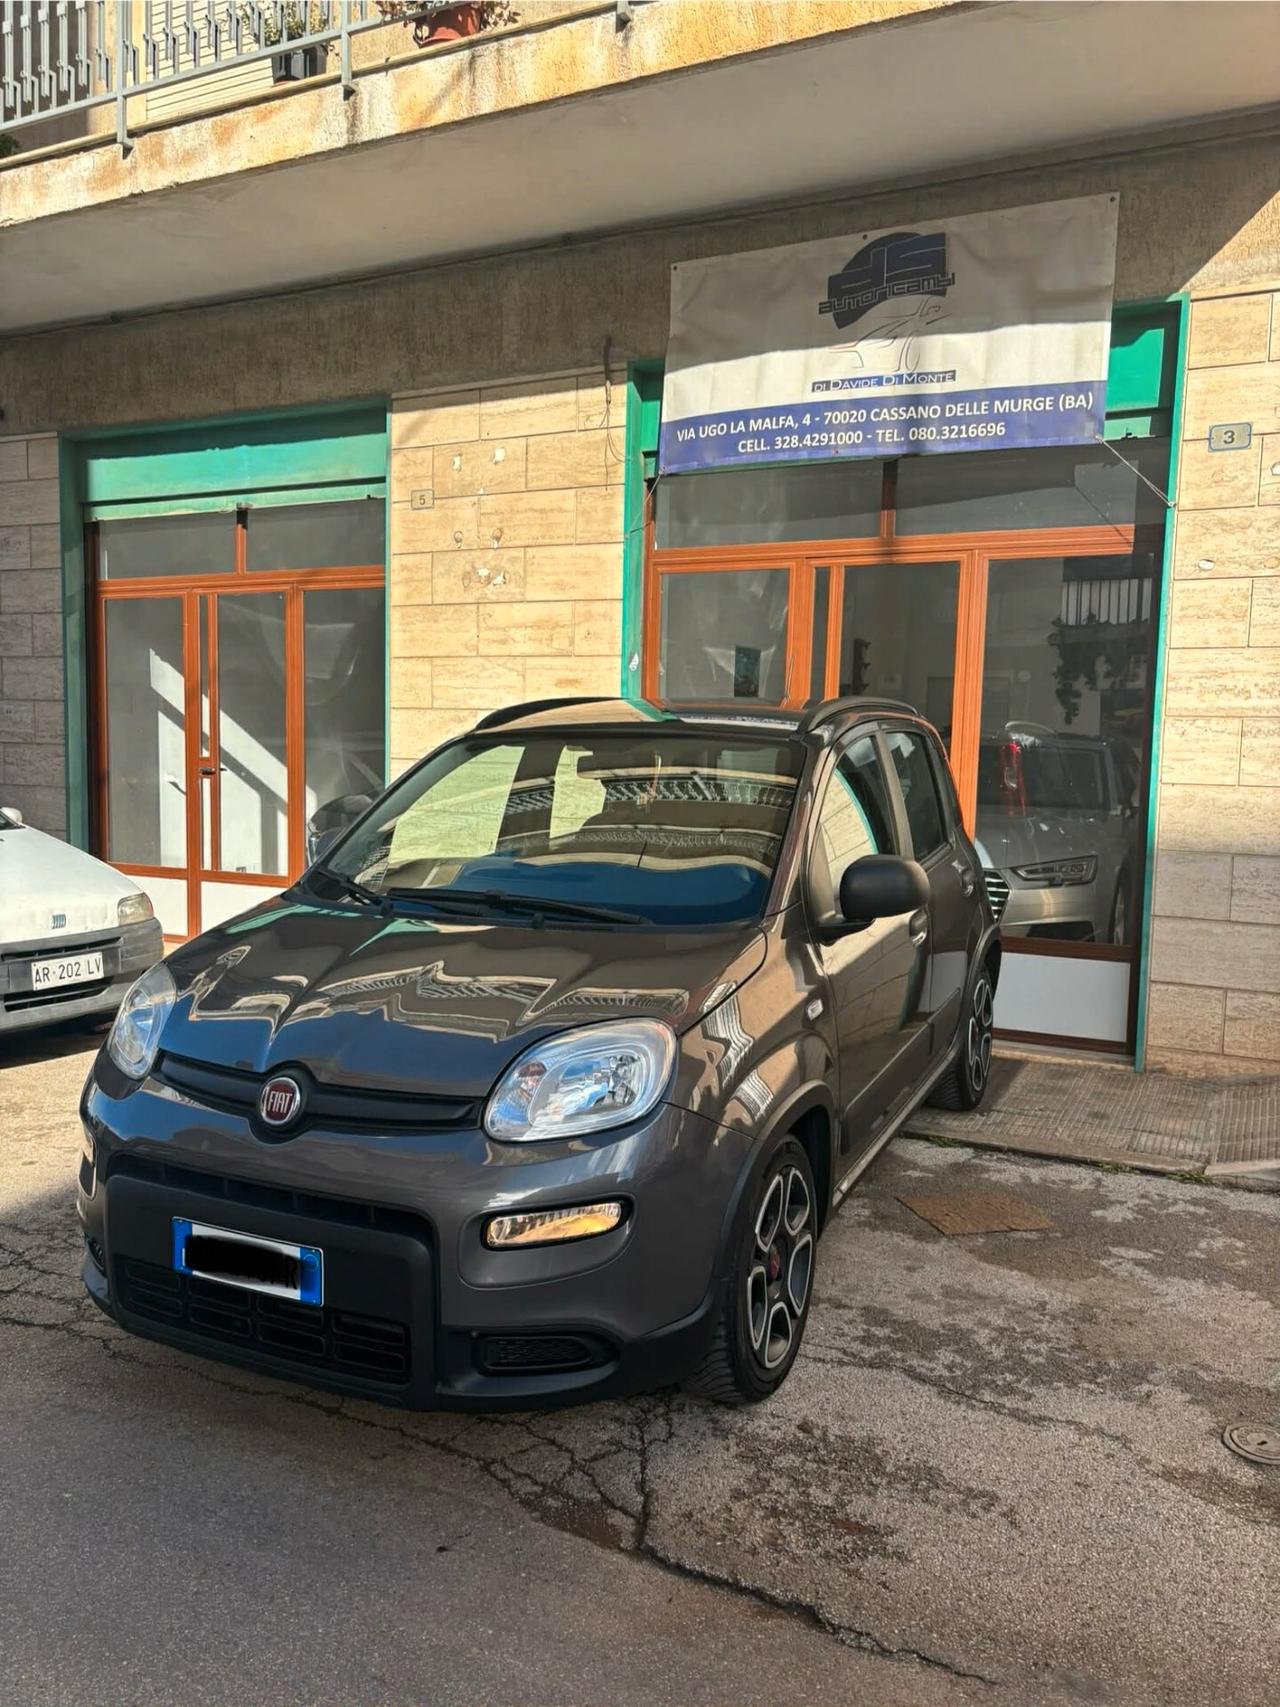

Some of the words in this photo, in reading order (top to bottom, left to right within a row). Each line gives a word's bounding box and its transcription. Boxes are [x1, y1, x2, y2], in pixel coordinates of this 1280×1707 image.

[676, 426, 696, 442] VIA
[699, 424, 727, 439] UGO
[730, 420, 746, 434] LA
[749, 414, 799, 432] MALFA,
[802, 413, 811, 426] 4
[823, 408, 867, 425] 70020
[870, 404, 941, 422] CASSANO
[945, 400, 990, 416] DELLE
[994, 396, 1054, 413] MURGE
[1058, 391, 1094, 412] (BA)
[738, 438, 770, 453] CELL.
[774, 430, 863, 449] 328.4291000
[876, 427, 904, 443] TEL.
[908, 422, 1006, 441] 080.3216696
[1223, 430, 1235, 445] 3
[419, 494, 426, 506] 5
[34, 967, 51, 984] AR
[58, 961, 81, 980] 202
[87, 957, 102, 975] LV
[267, 1090, 293, 1114] FIAT
